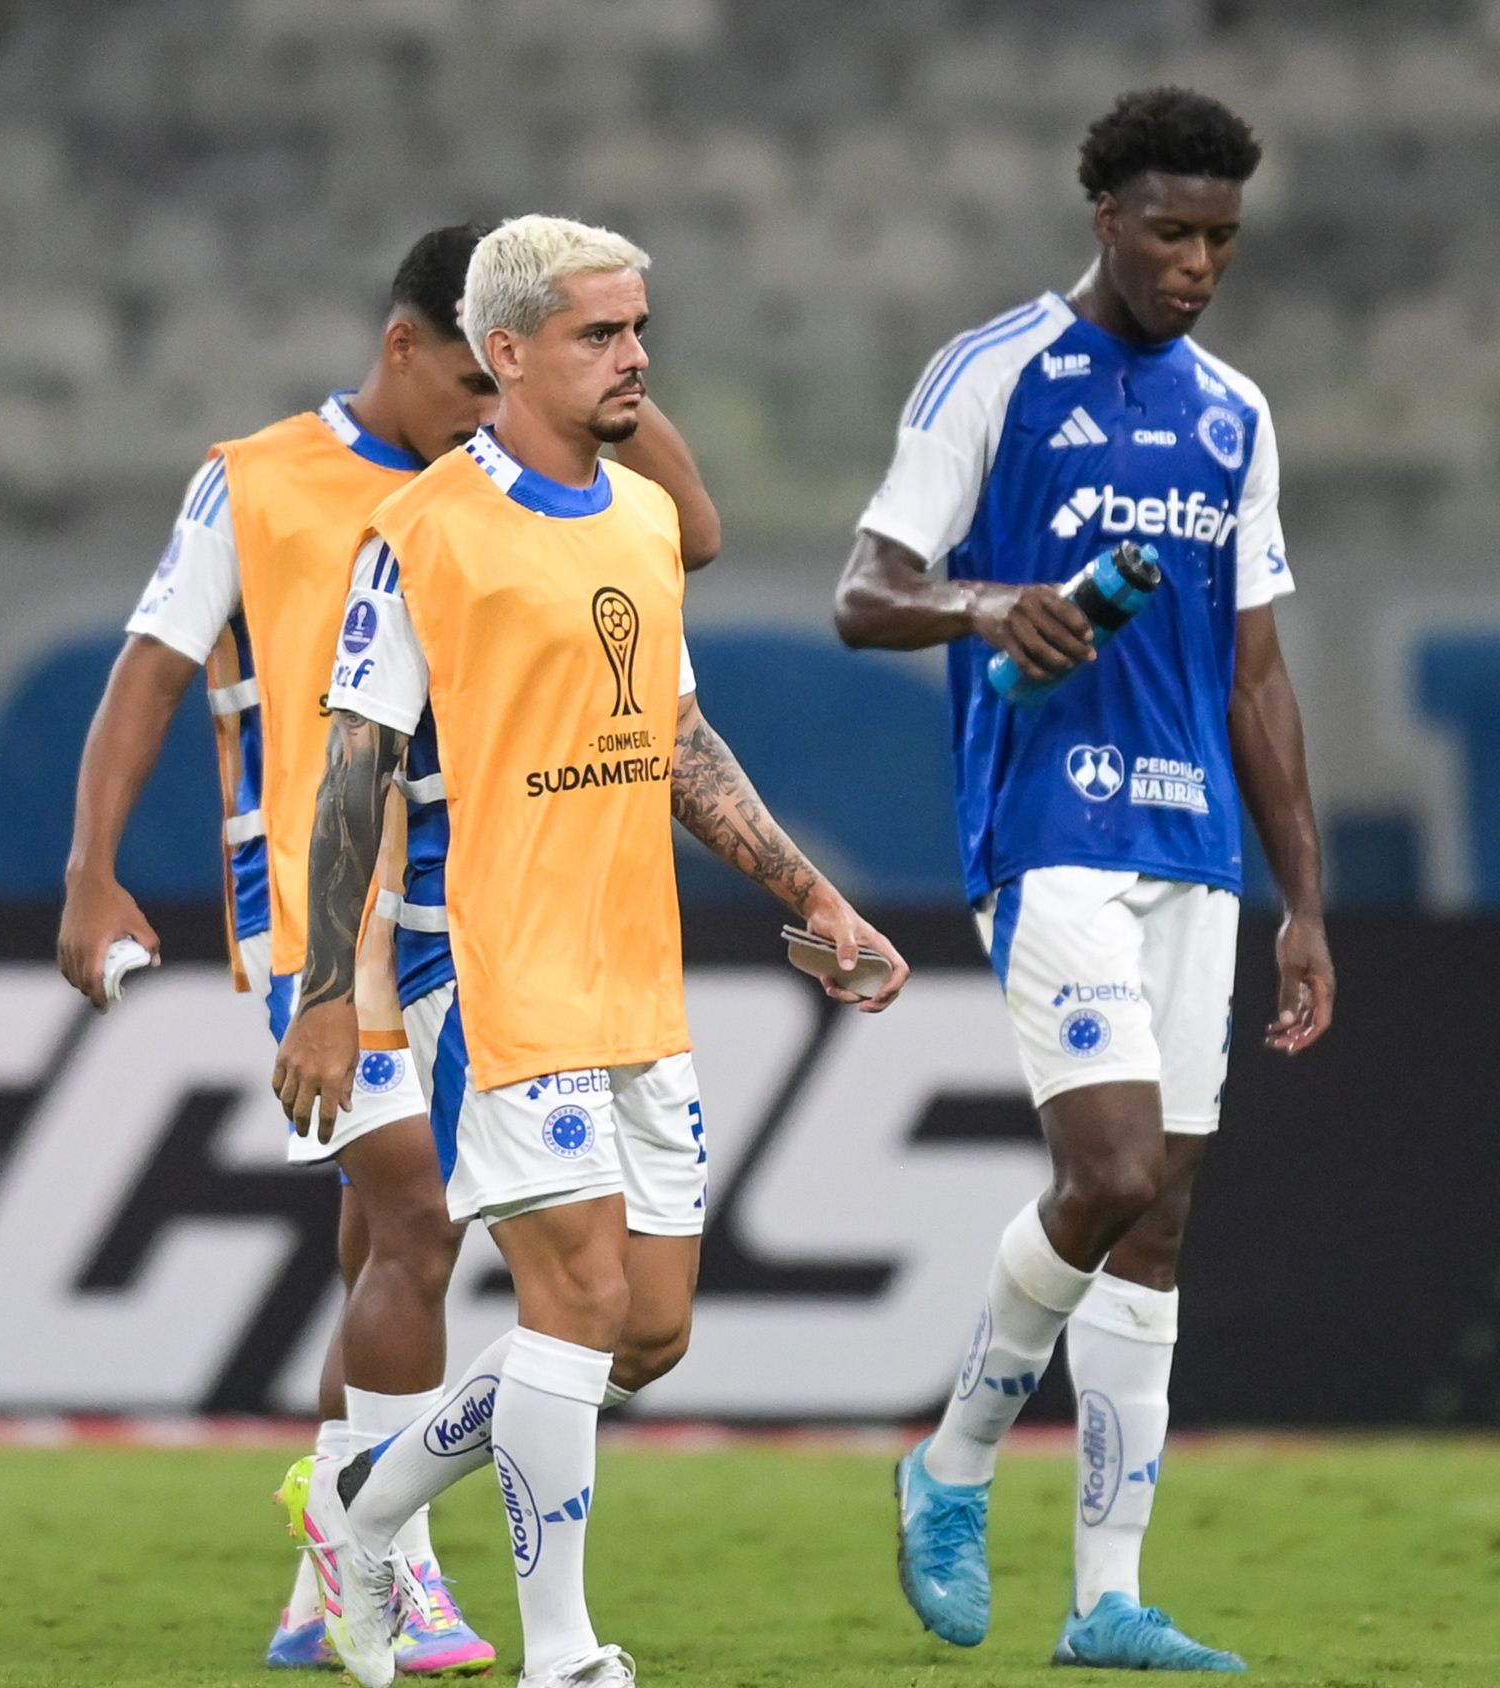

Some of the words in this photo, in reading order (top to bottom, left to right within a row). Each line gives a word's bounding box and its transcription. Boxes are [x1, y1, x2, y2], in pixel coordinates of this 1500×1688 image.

[1133, 429, 1177, 447] CIMED
[1102, 484, 1238, 547] betfair
[1083, 1400, 1107, 1510] Kodilar
